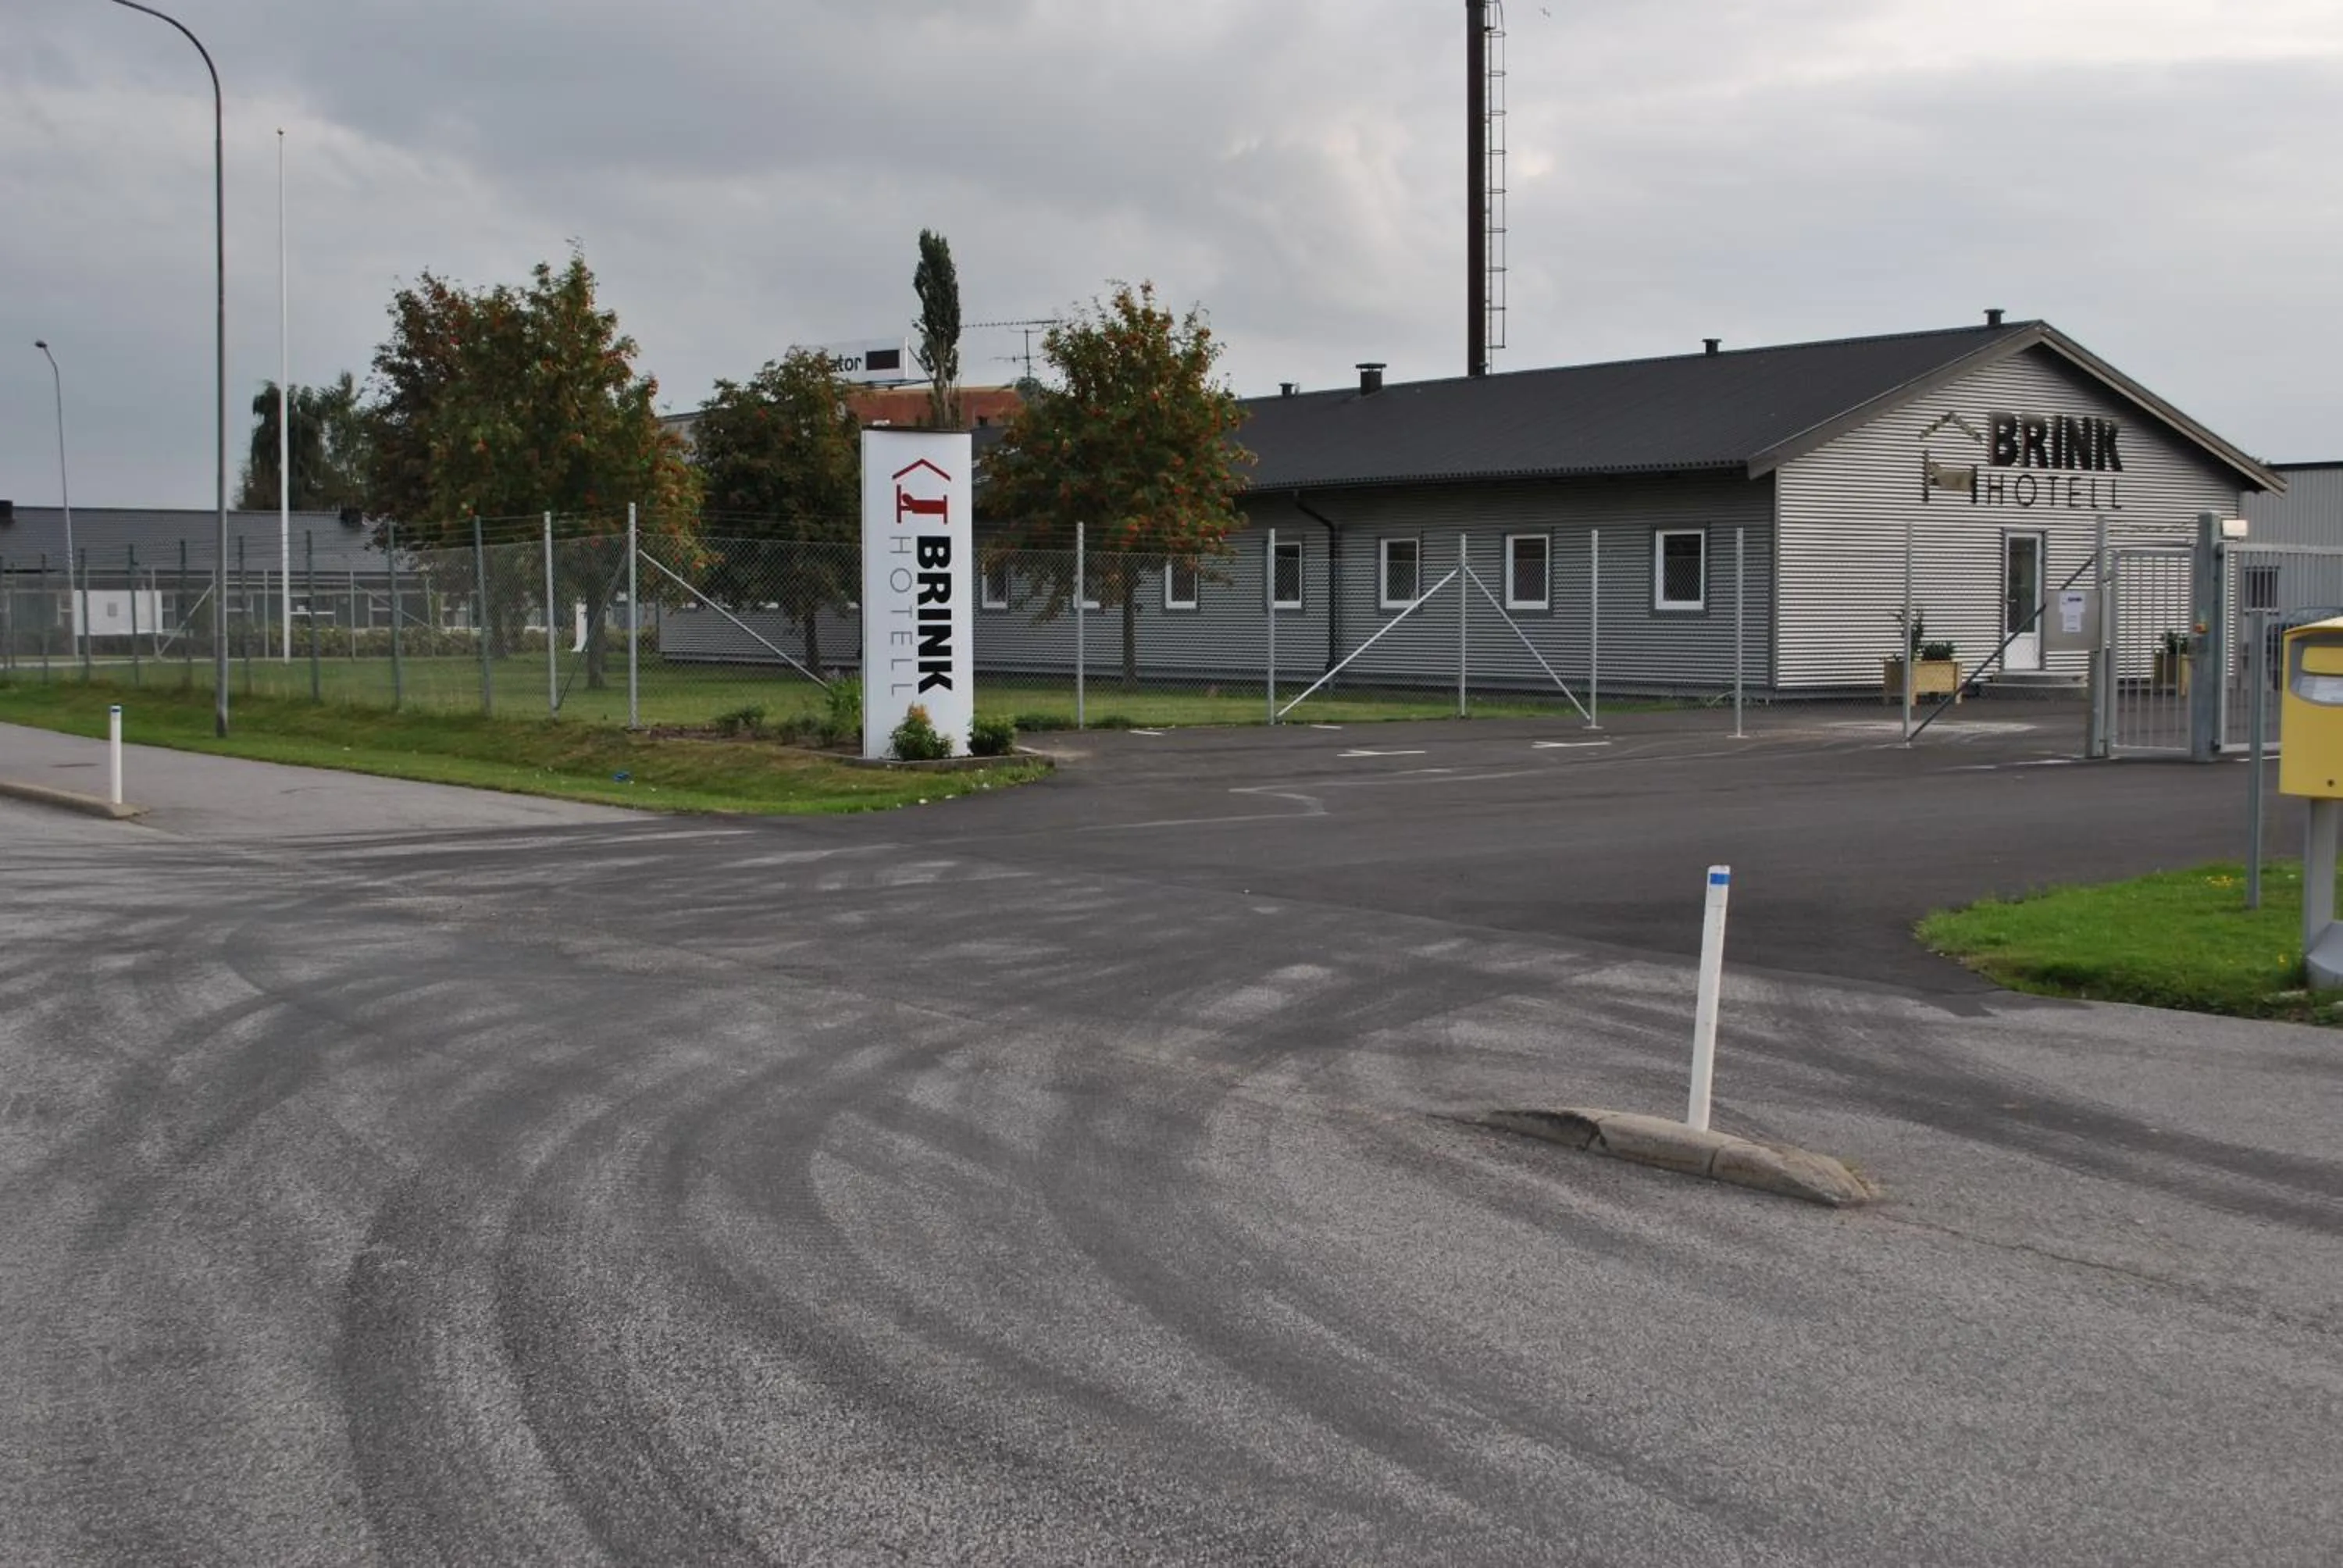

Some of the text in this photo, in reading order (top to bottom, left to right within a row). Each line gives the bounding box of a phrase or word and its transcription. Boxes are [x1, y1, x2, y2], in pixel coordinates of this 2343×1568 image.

[1988, 410, 2124, 472] BRINK
[1988, 473, 2122, 509] HOTELL
[890, 536, 913, 697] HOTELL
[917, 536, 953, 694] BRINK
